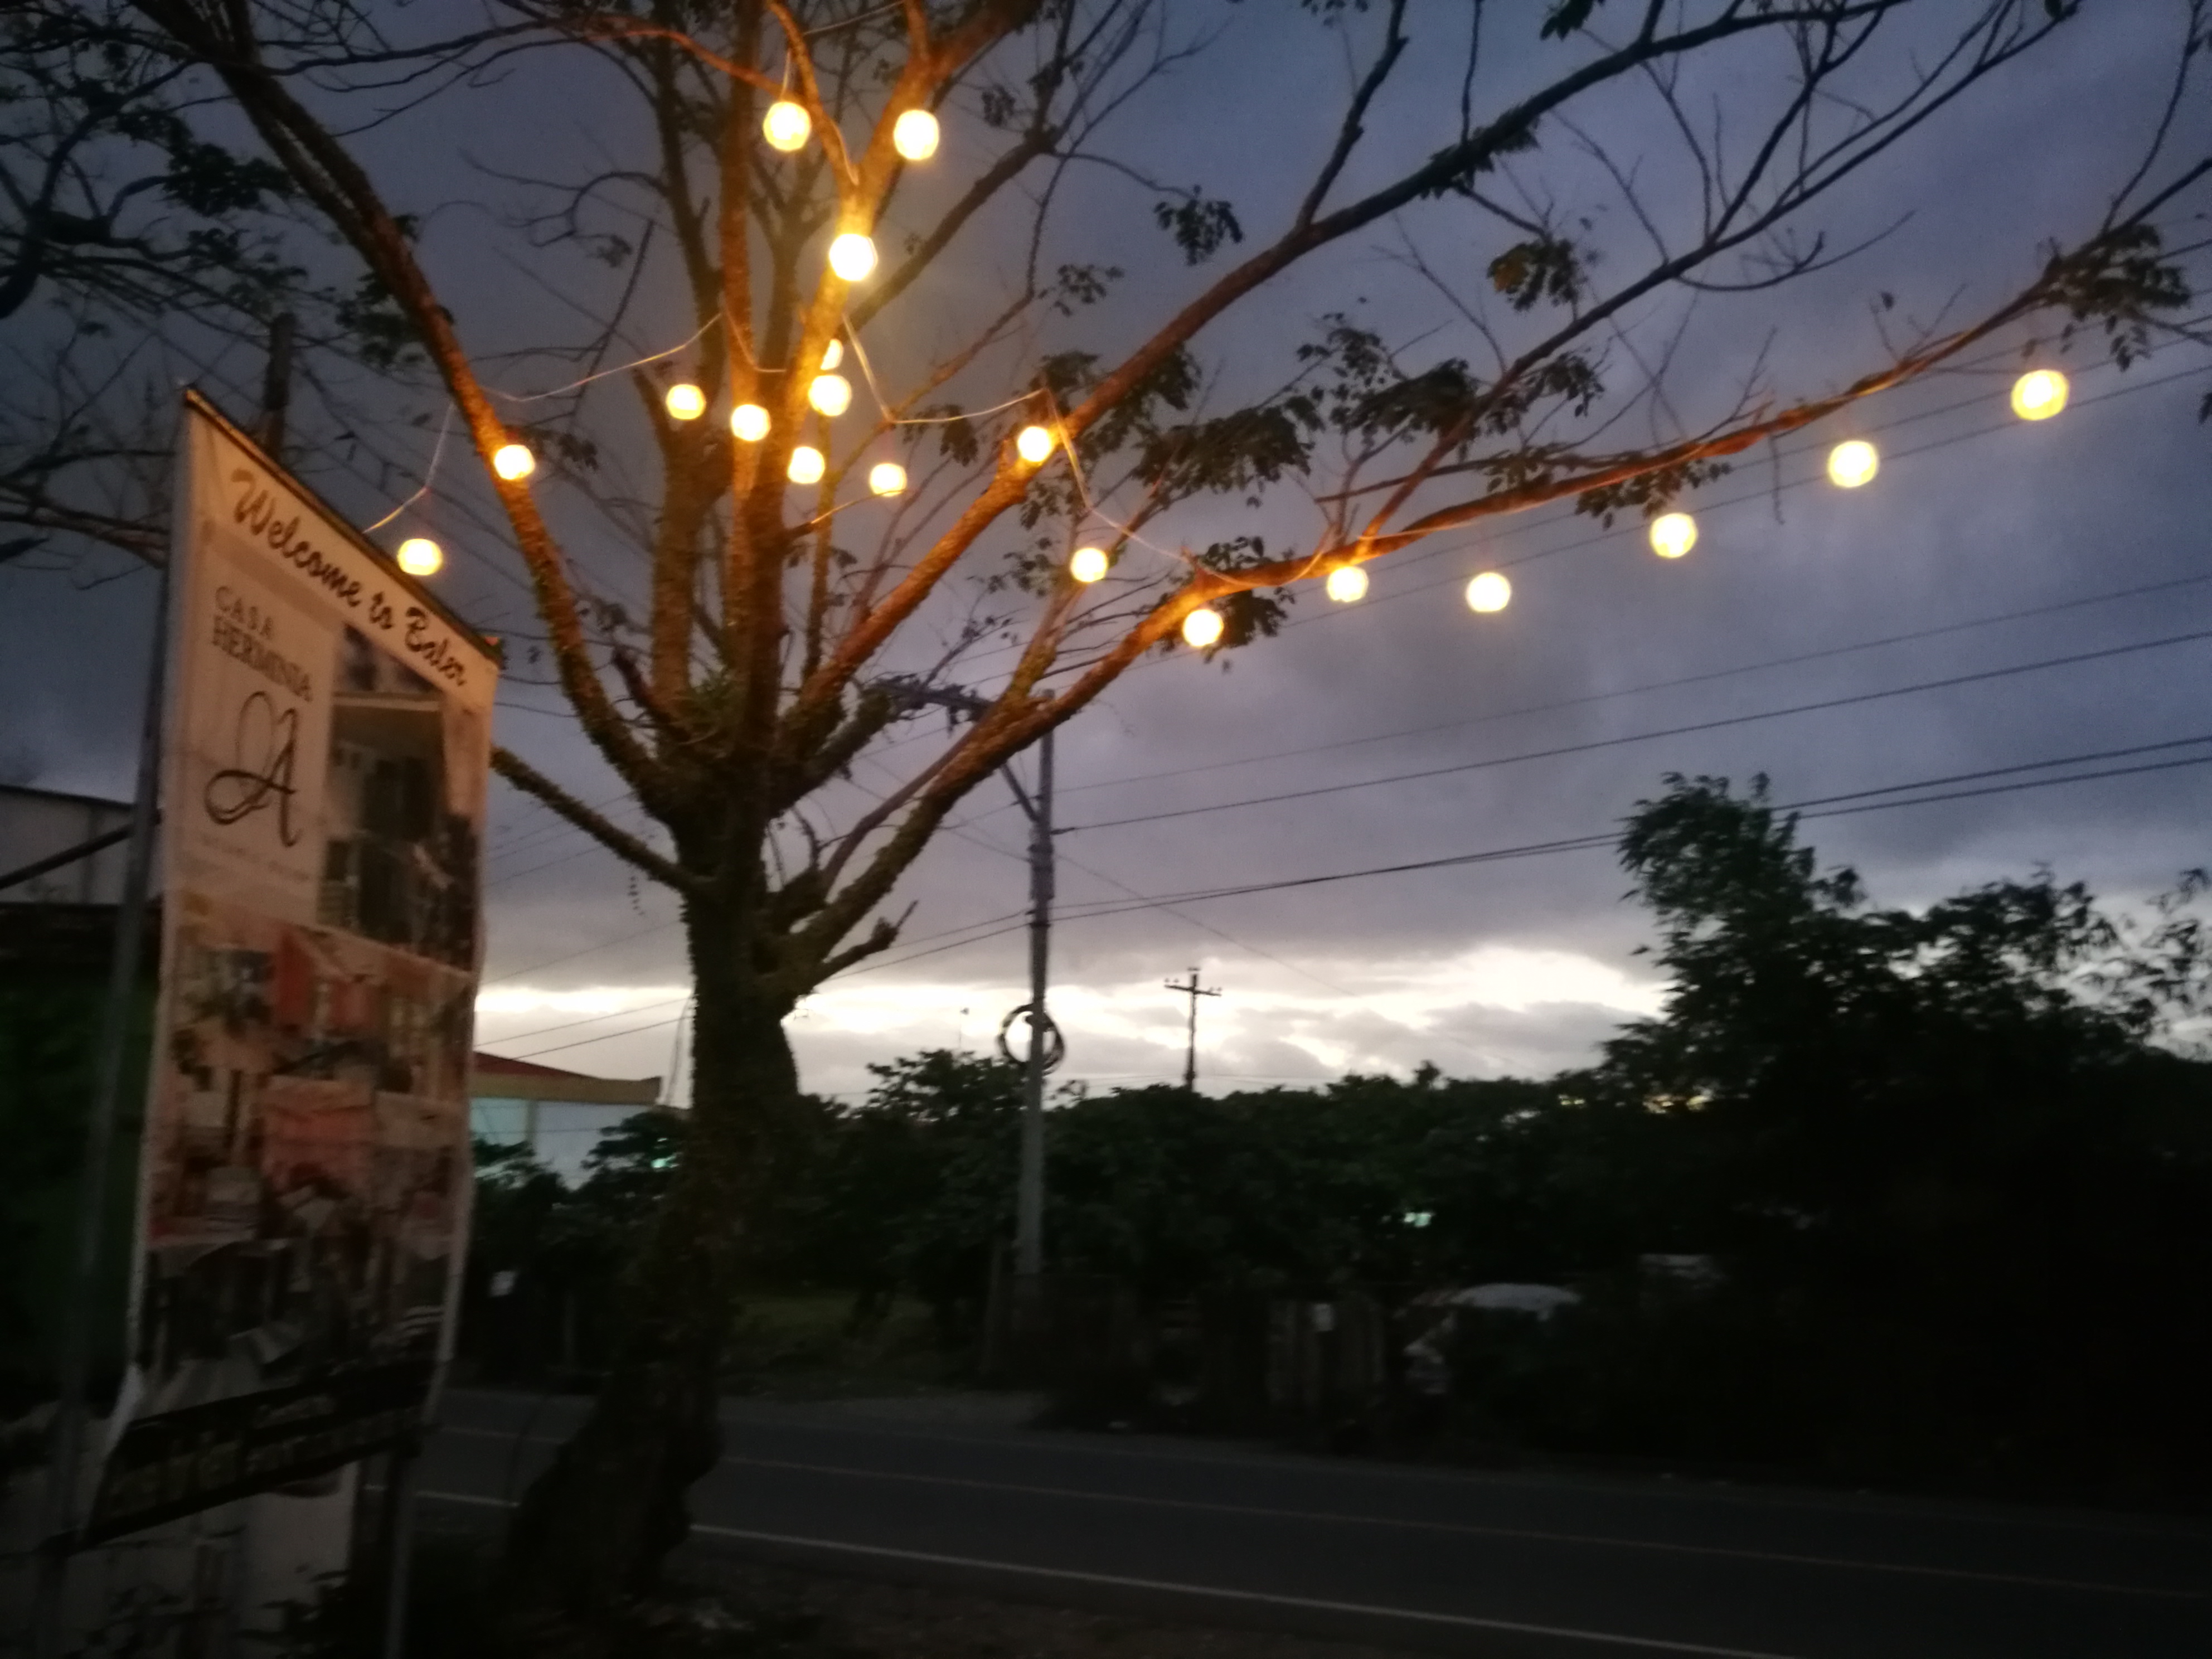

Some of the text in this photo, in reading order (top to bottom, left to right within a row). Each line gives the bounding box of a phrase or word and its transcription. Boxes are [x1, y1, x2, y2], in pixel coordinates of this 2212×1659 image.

[231, 468, 362, 608] Welcome
[369, 591, 394, 630] to
[215, 585, 274, 641] CASA
